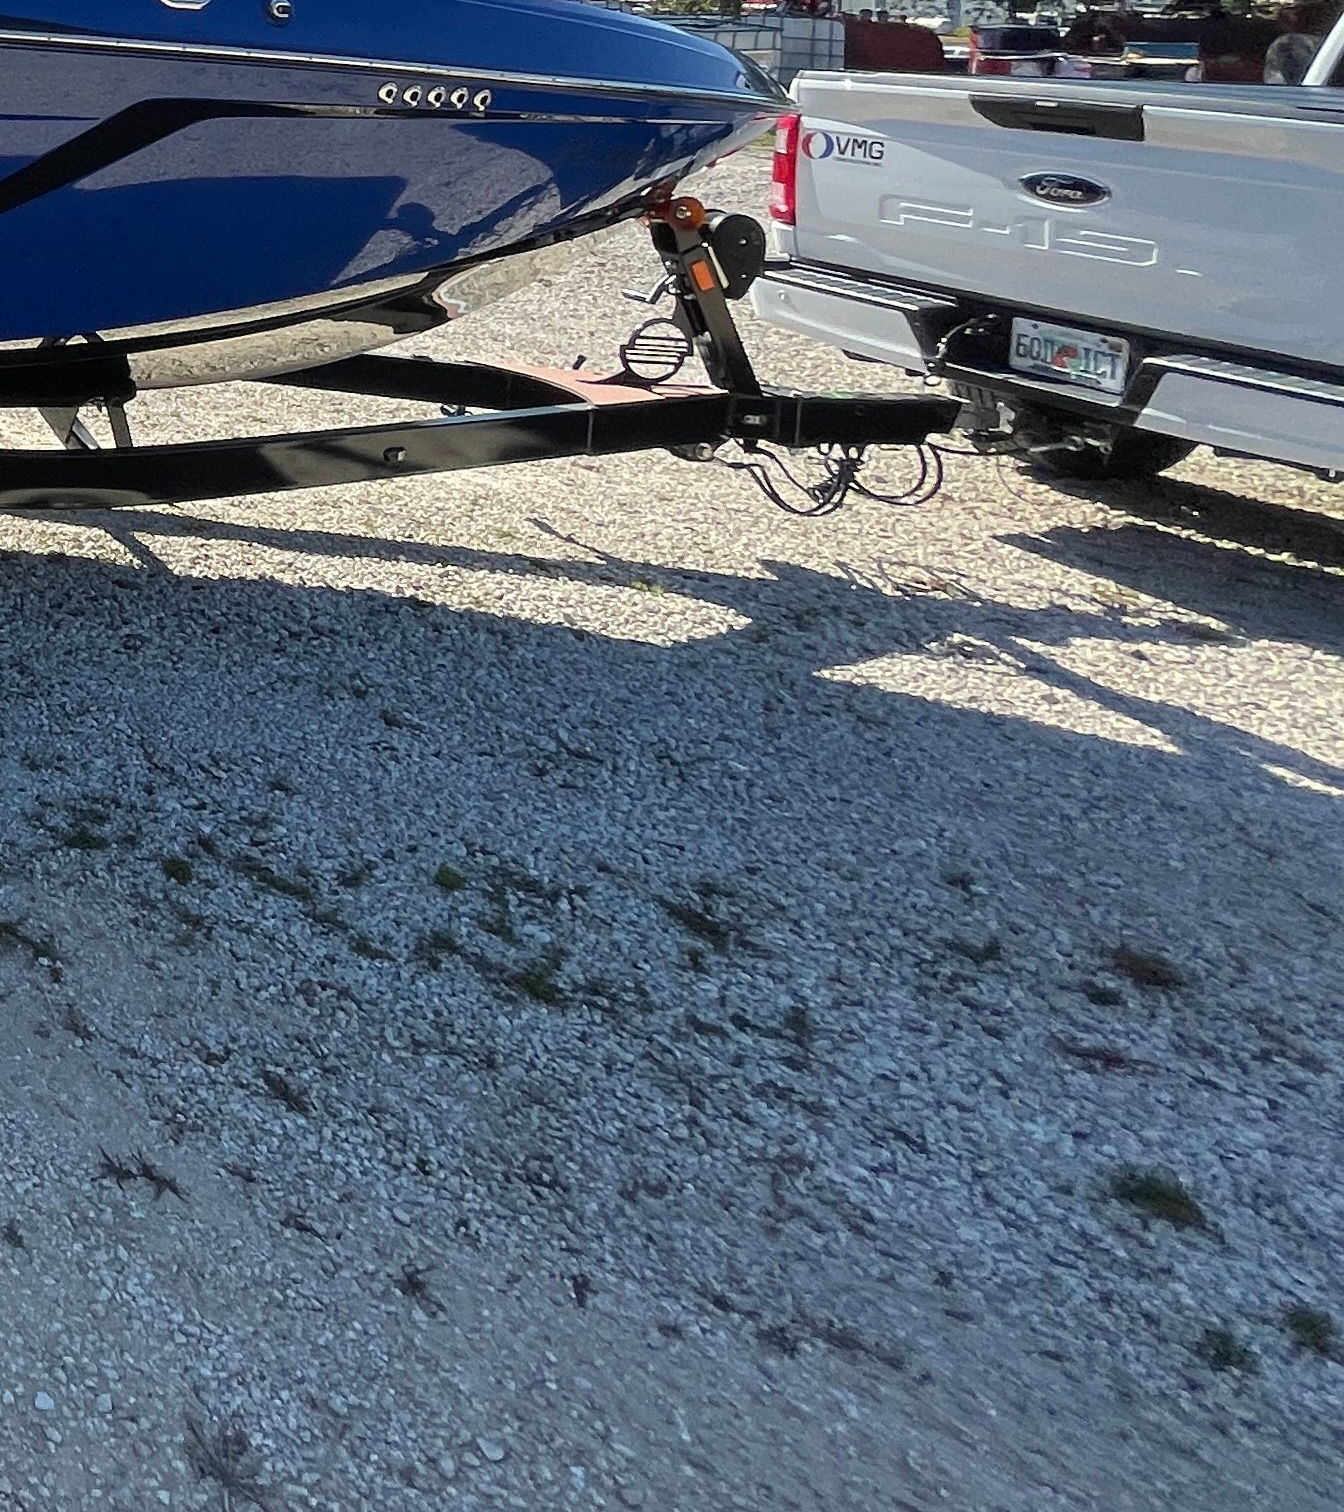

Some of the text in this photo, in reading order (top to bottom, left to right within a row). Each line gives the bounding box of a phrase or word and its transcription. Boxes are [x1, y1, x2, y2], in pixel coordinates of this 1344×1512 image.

[835, 136, 885, 160] VMG
[1035, 176, 1083, 200] Ford
[879, 194, 1205, 277] F-15
